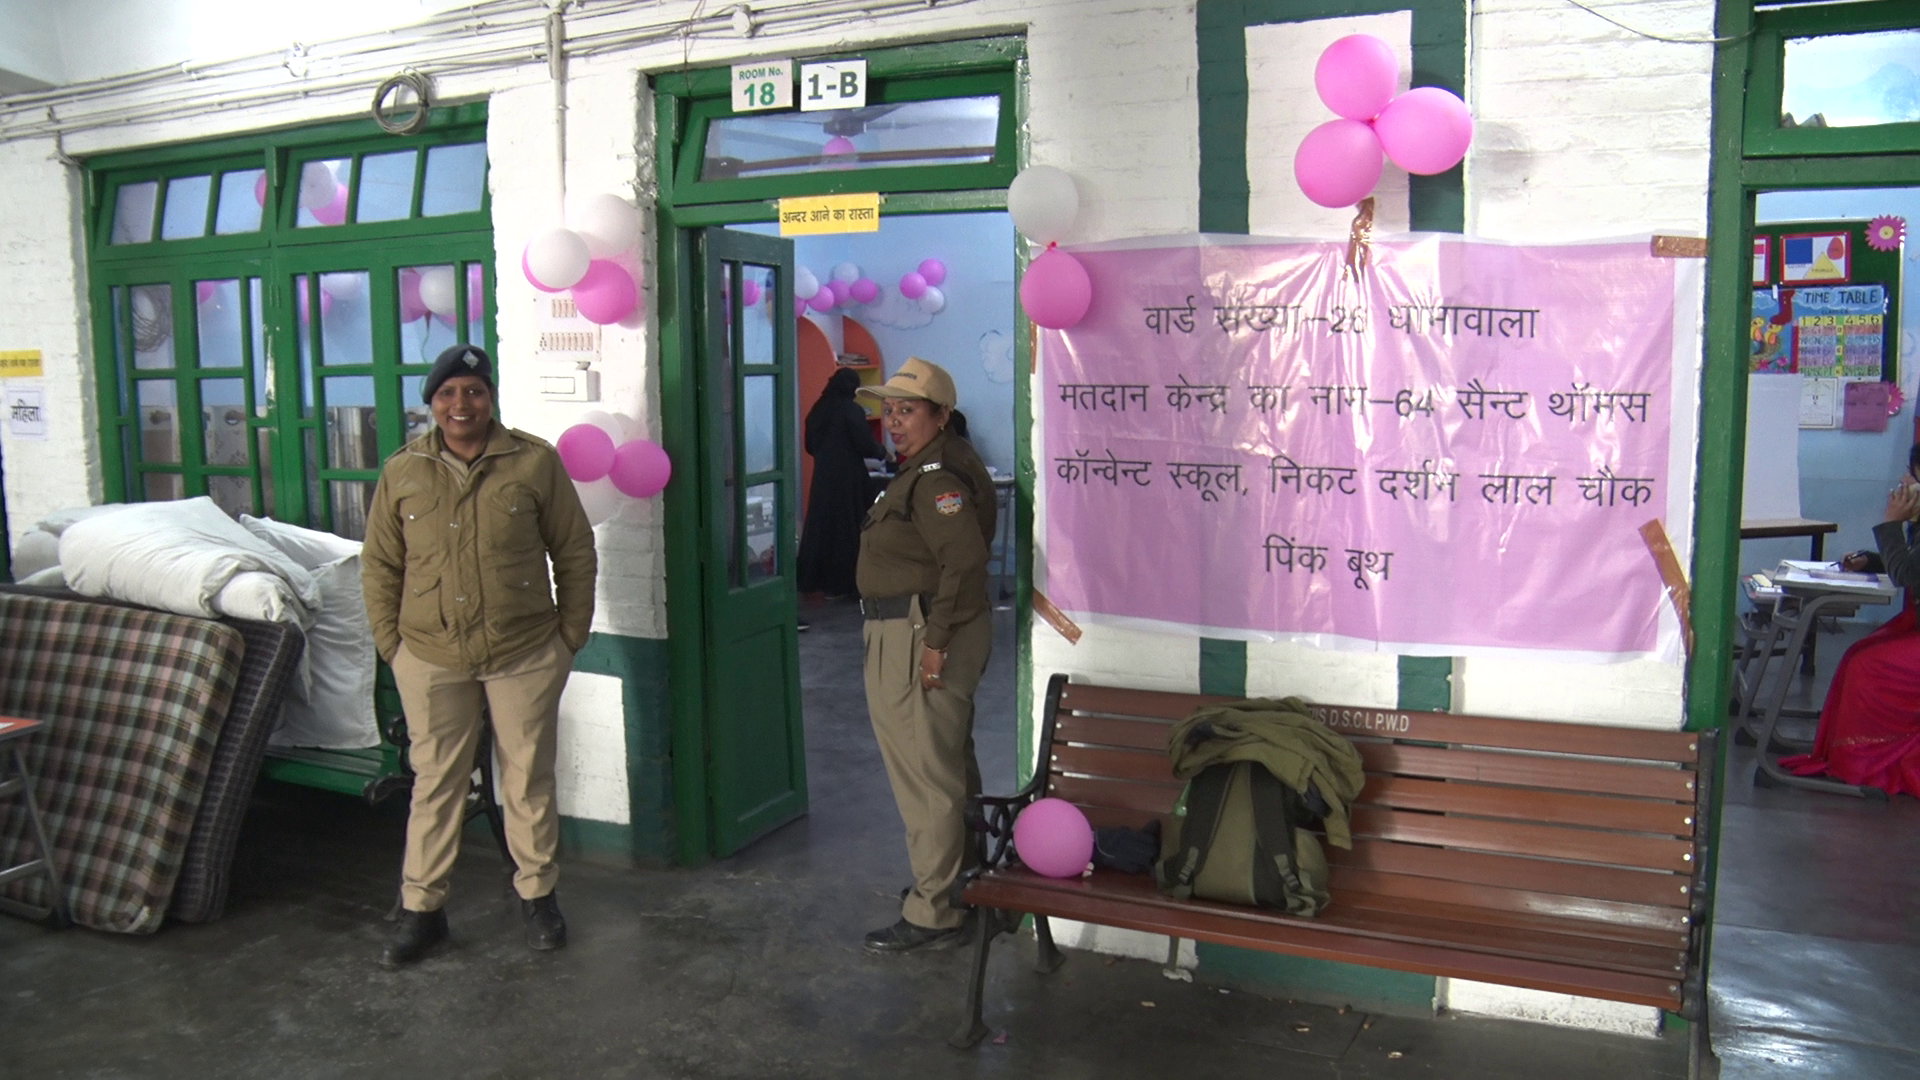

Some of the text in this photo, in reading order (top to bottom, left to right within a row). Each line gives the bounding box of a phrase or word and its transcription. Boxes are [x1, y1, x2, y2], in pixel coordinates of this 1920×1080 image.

[739, 67, 783, 80] ROOM No.
[808, 71, 858, 100] 1-B
[744, 82, 775, 106] 18
[782, 205, 875, 223] अन्दर आने का रास्ता
[1805, 289, 1878, 305] TIME TABLE
[1143, 296, 1196, 335] वार्ड
[1813, 317, 1821, 326] 2
[1827, 316, 1834, 325] 3
[1846, 316, 1854, 324] 4
[1859, 315, 1866, 324] 5
[1871, 314, 1880, 324] 6
[1058, 384, 1150, 412] मतदान
[1165, 374, 1231, 415] केन्द्र
[1247, 386, 1290, 415] का
[1457, 379, 1528, 420] सैन्ट
[1548, 382, 1651, 423] थॉमस
[10, 399, 39, 424] महिला
[1054, 449, 1655, 507] कॉन्वेन्ट स्कूल, निकट दर्शन लाल चौक
[1262, 534, 1394, 590] पिंक बूथ
